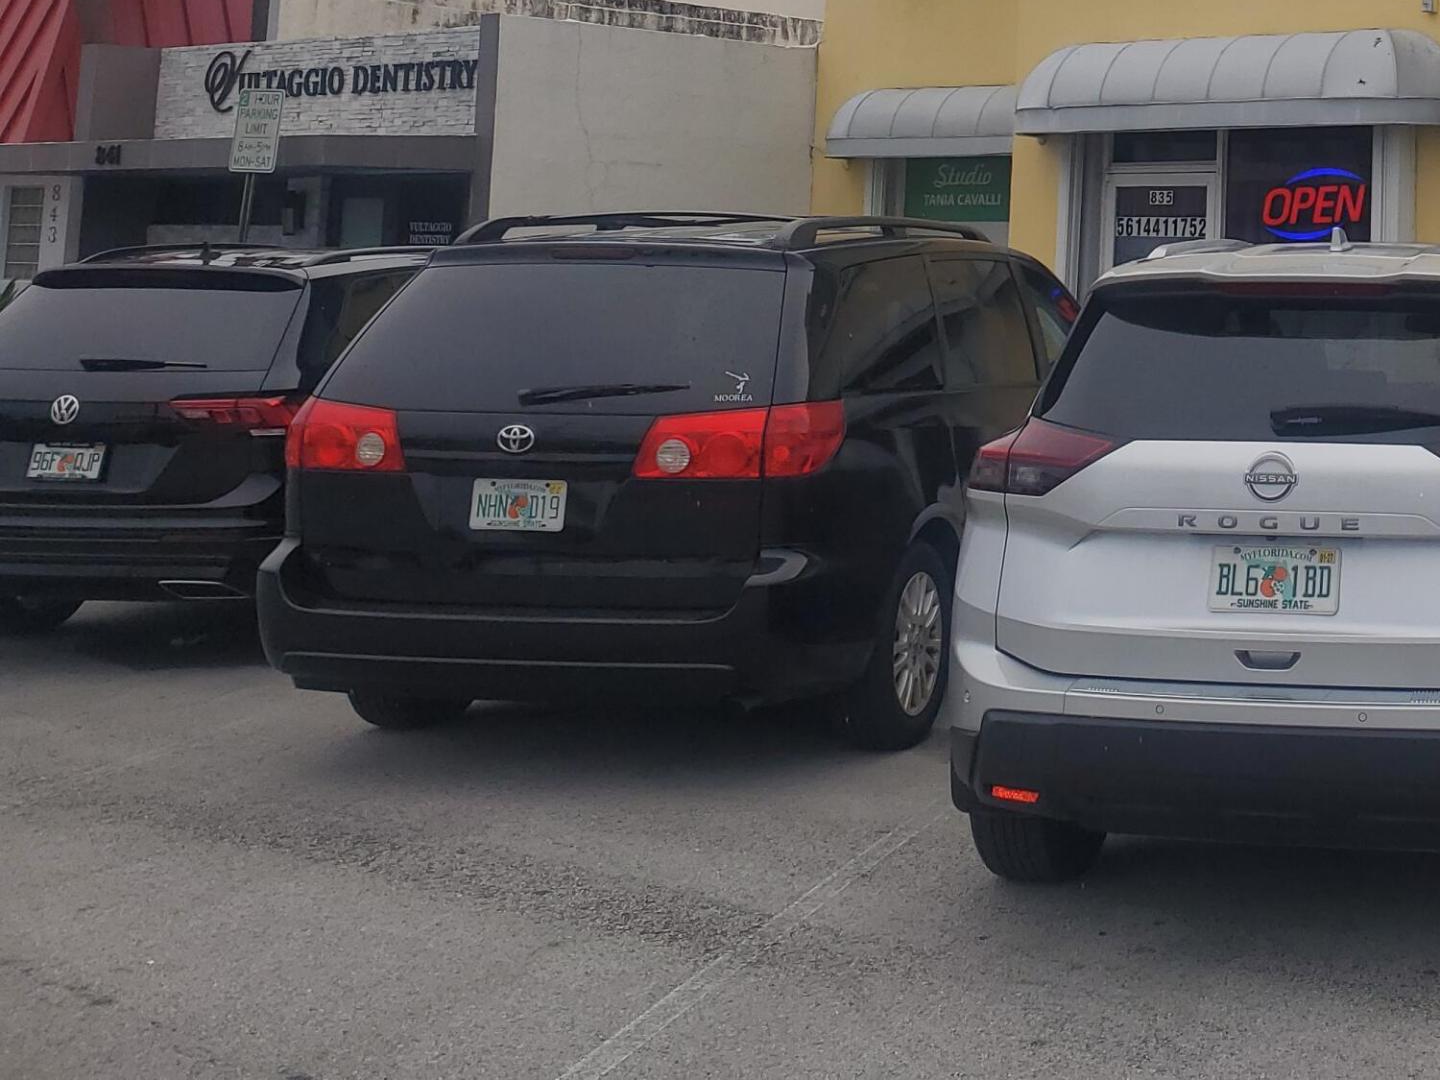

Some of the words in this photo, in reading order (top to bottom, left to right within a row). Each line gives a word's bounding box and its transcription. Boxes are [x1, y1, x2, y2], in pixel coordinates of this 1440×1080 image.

[351, 59, 478, 94] DENTISTRY
[255, 93, 280, 105] HOUR
[240, 108, 278, 120] PARKING
[245, 123, 267, 135] LIMIT
[233, 155, 271, 168] MON-SAT
[934, 164, 992, 188] Studio
[923, 193, 955, 207] TANIA
[957, 192, 1001, 206] CAVALLI
[1150, 191, 1173, 204] 835
[1262, 183, 1367, 227] OPEN
[1117, 217, 1207, 237] 5614411752
[1245, 474, 1297, 483] NISSAN
[1177, 514, 1360, 531] ROGUE
[1236, 598, 1279, 609] SUNSHINE
[1281, 599, 1309, 610] STATE
